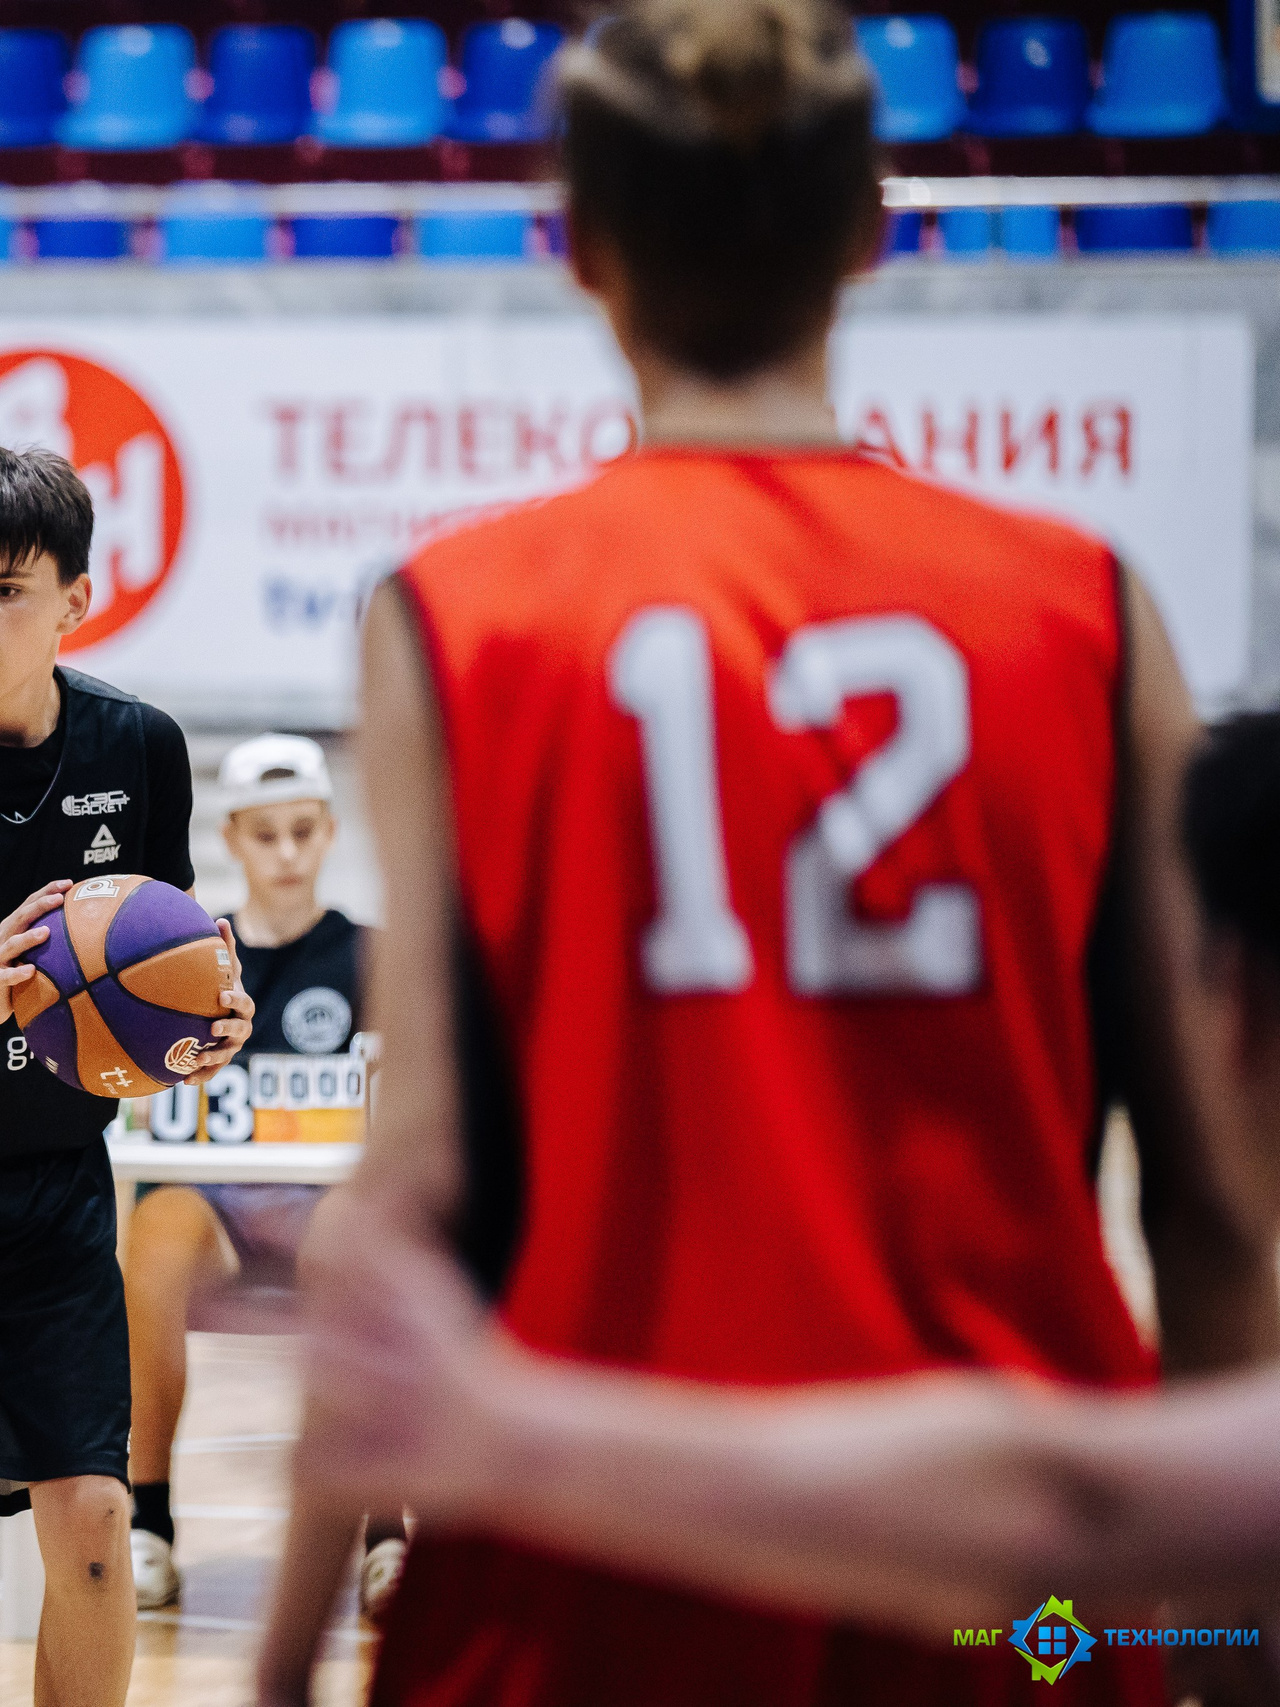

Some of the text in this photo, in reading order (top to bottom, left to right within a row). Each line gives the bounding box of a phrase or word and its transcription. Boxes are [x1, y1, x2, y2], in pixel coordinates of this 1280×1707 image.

[266, 400, 1132, 474] ТЕЛЕКОАНИЯ
[606, 605, 984, 998] 12
[83, 844, 122, 865] PEAK
